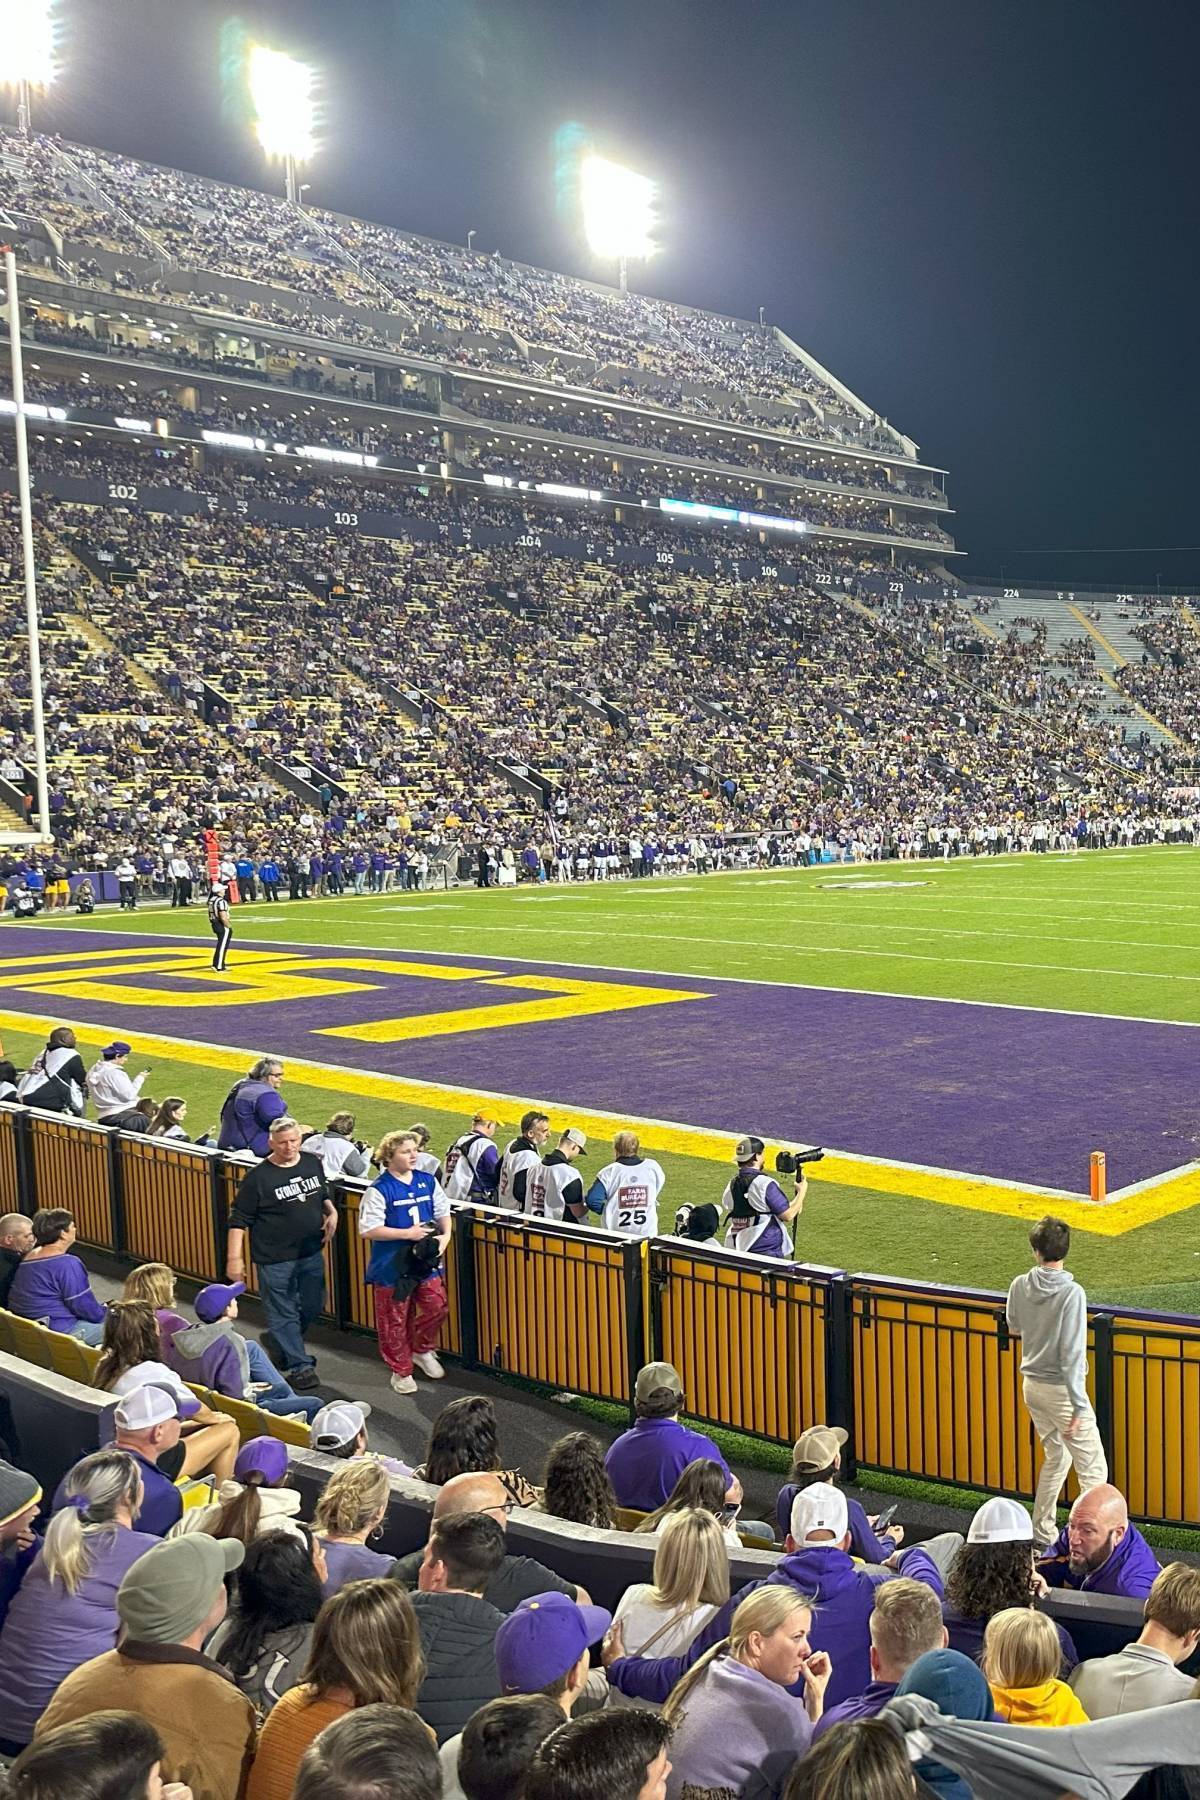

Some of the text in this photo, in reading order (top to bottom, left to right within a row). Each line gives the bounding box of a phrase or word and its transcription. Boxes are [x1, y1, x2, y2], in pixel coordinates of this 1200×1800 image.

[108, 484, 138, 500] 102
[334, 512, 358, 525] 103
[520, 535, 541, 548] 104
[656, 553, 674, 564] 105
[761, 566, 777, 577] 106
[815, 574, 832, 585] 222
[889, 582, 904, 592] 223
[1003, 589, 1019, 598] 224
[275, 1182, 302, 1200] GEORGIA
[301, 1176, 321, 1192] STATE
[621, 1193, 646, 1201] BUREAU
[408, 1205, 420, 1225] 1
[619, 1210, 647, 1227] 25
